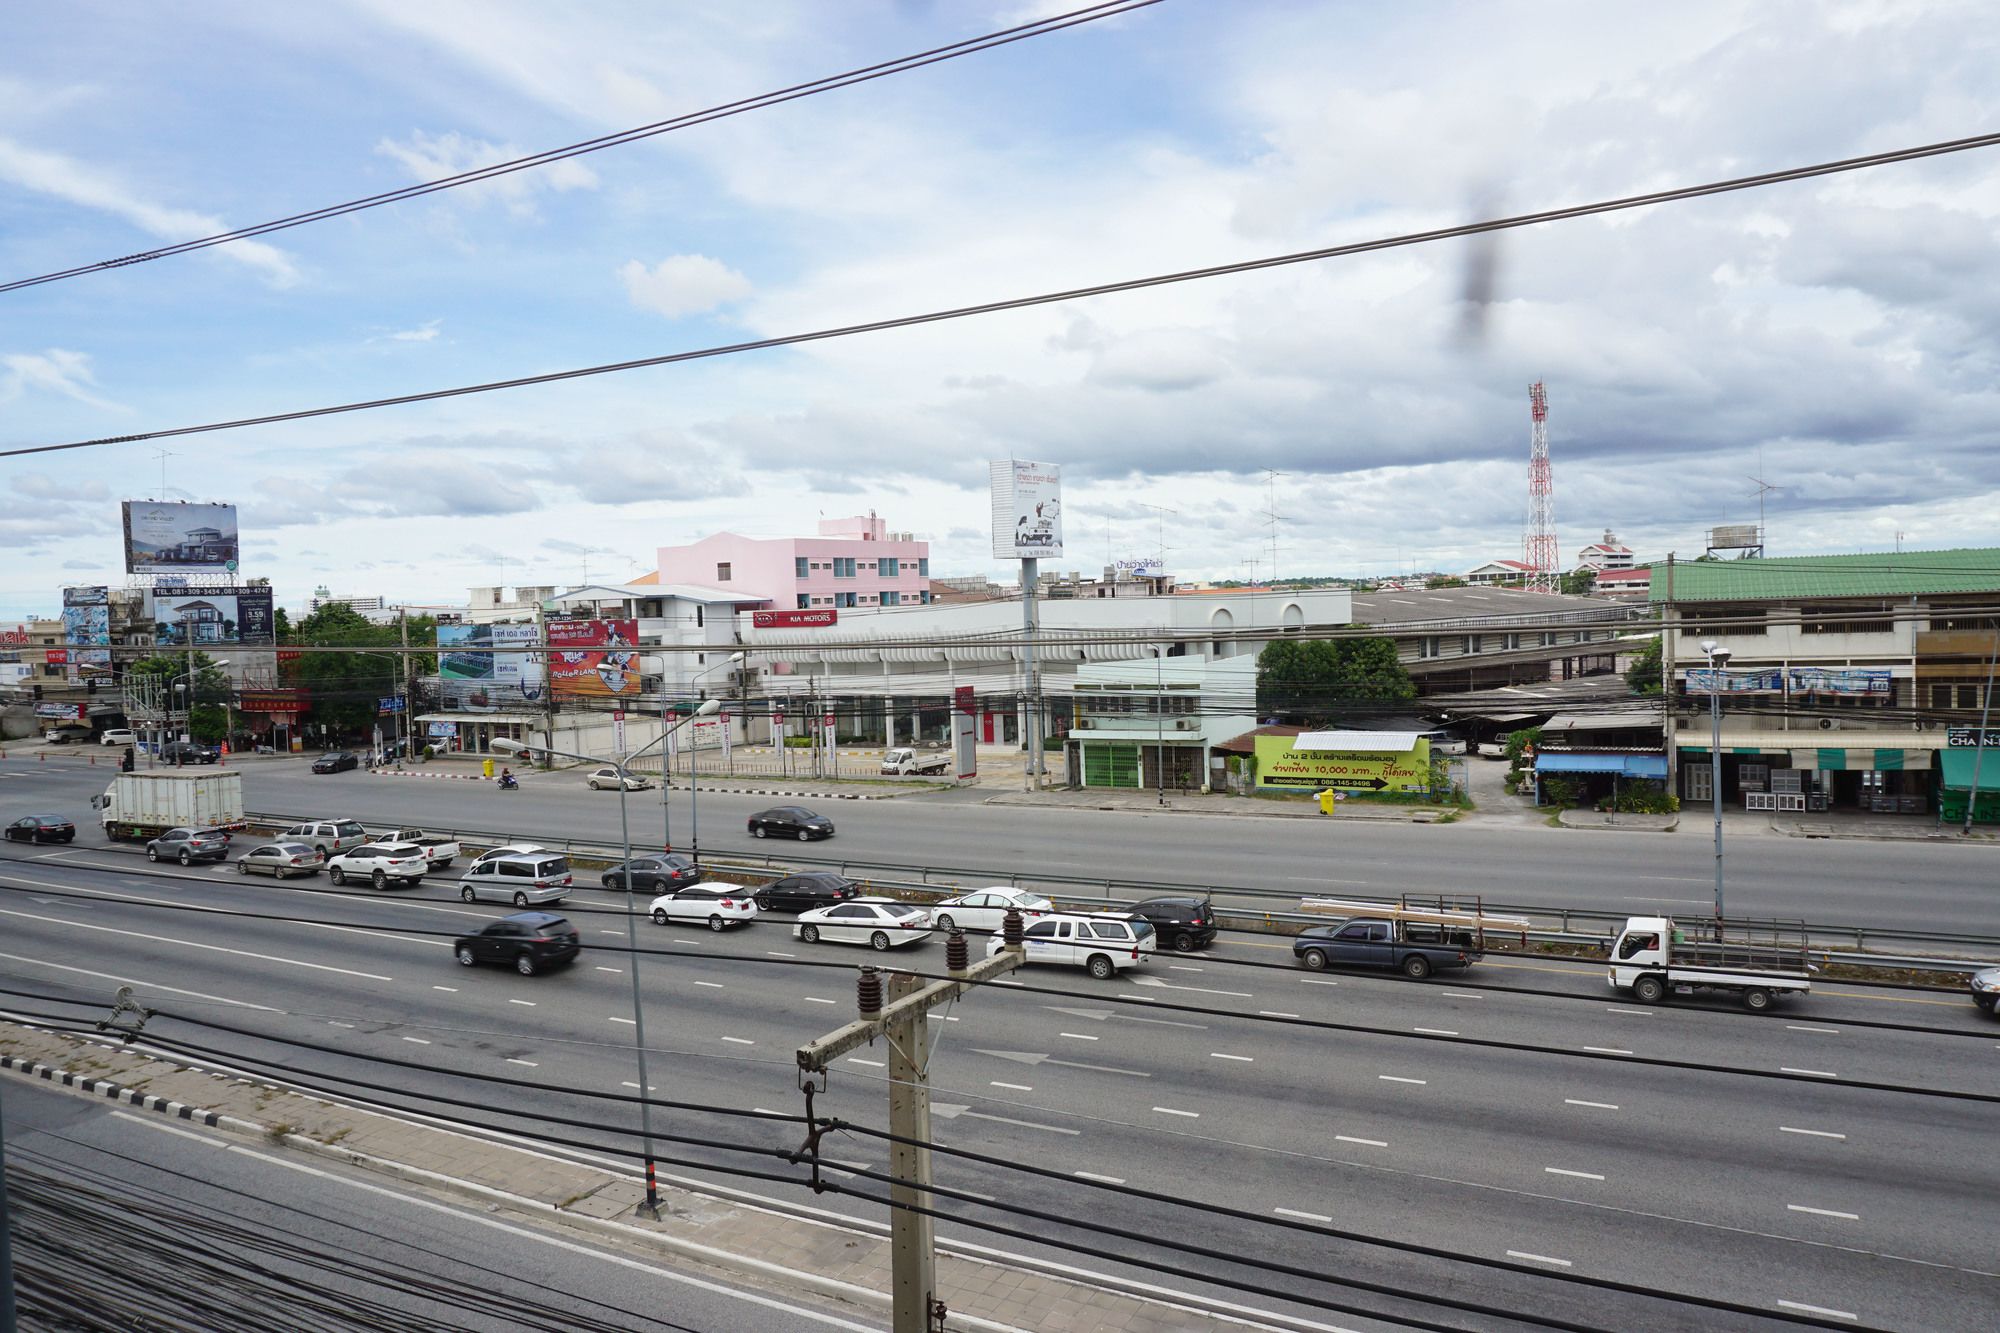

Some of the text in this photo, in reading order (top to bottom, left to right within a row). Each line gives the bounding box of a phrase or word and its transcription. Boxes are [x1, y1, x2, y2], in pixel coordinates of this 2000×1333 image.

[1272, 761, 1309, 773] จ่ายเพียง
[1315, 766, 1348, 775] 10,000
